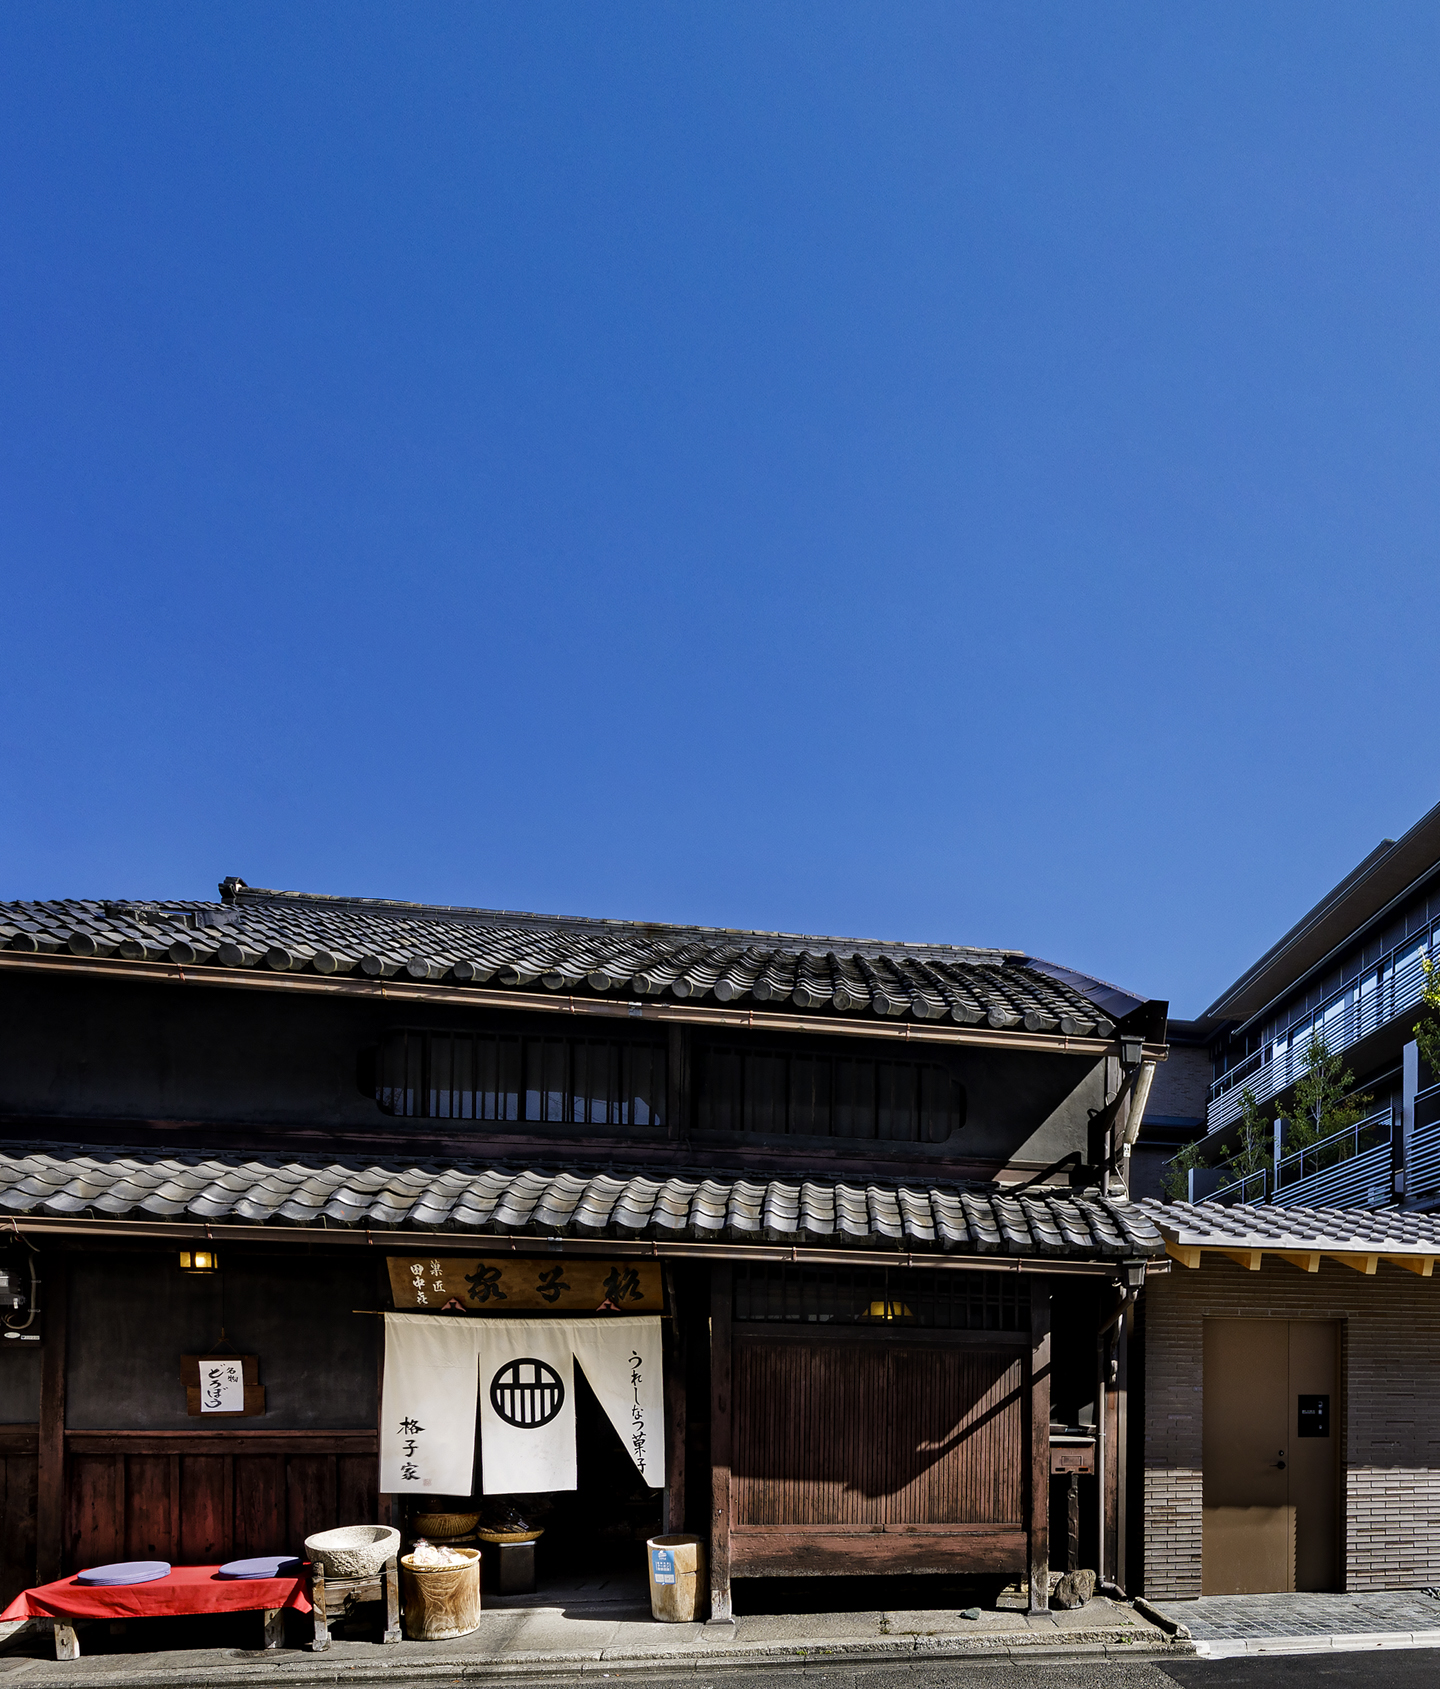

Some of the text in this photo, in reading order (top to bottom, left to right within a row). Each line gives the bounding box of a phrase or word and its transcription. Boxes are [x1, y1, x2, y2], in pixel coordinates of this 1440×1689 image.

[204, 1363, 229, 1409] どろぼう
[226, 1367, 239, 1383] 名物
[628, 1350, 647, 1475] うれしなつ菓子
[396, 1416, 426, 1481] 格子家
